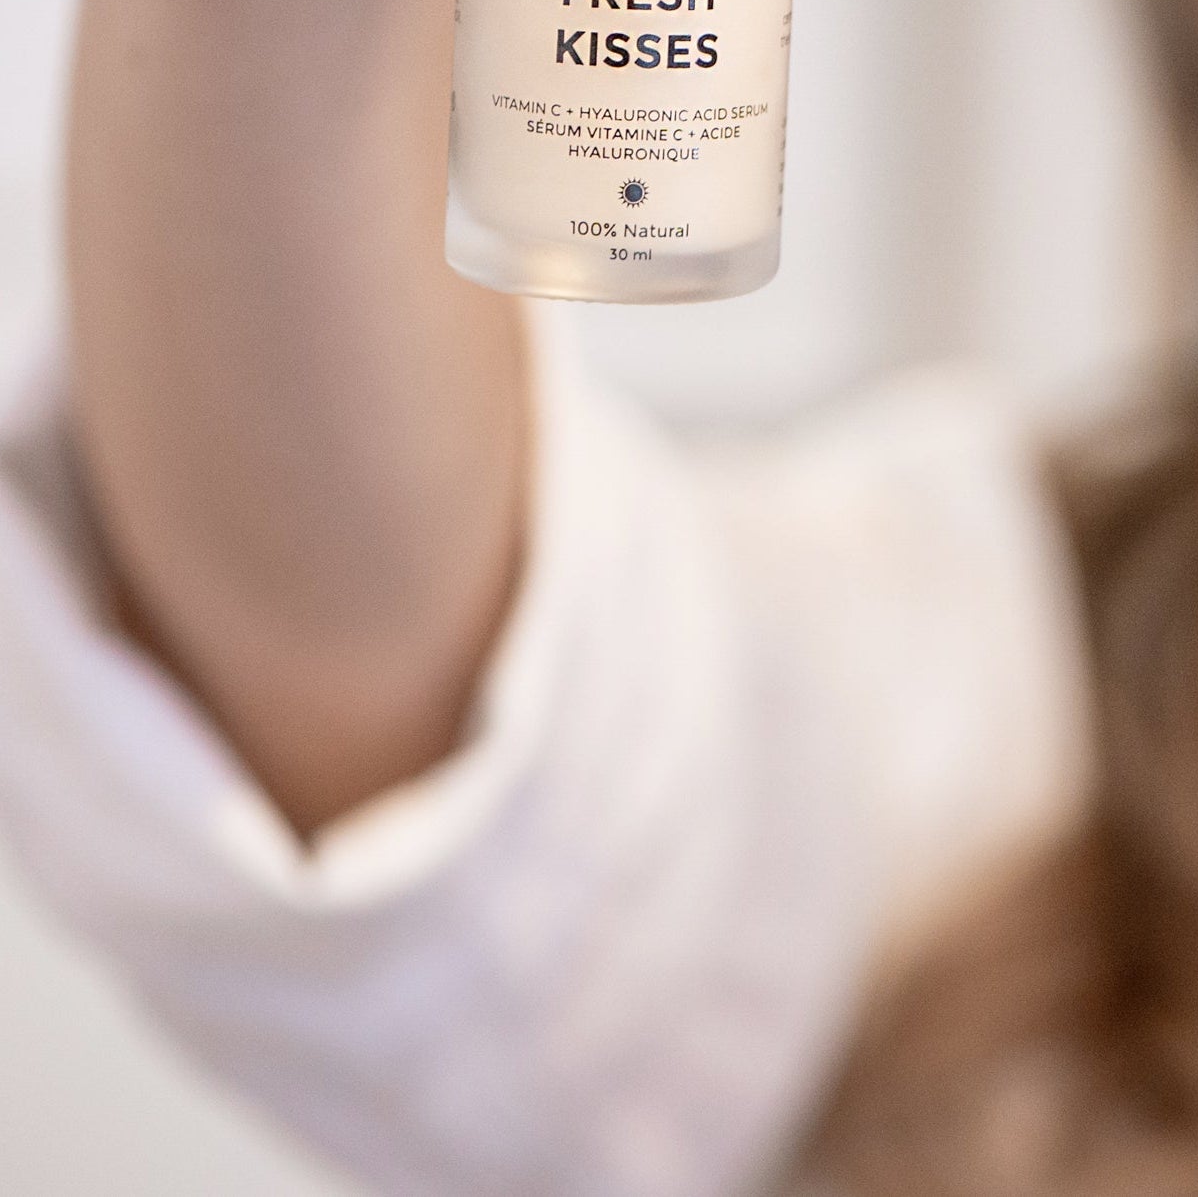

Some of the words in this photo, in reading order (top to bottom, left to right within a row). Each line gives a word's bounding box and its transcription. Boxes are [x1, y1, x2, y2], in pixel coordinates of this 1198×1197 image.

[556, 28, 718, 69] KISSES
[492, 94, 545, 115] VITAMIN
[551, 104, 561, 117] C
[580, 107, 688, 122] HYALURONIC
[692, 107, 728, 121] ACID
[731, 102, 768, 120] SERUM
[526, 119, 582, 138] SÉRUM
[588, 126, 667, 142] VITAMINE
[673, 129, 683, 142] C
[700, 126, 741, 140] ACIDE
[568, 145, 699, 162] HYALURONIQUE
[570, 220, 617, 238] 100%
[623, 223, 690, 239] Natural
[609, 248, 628, 261] 30
[633, 248, 652, 261] ml
